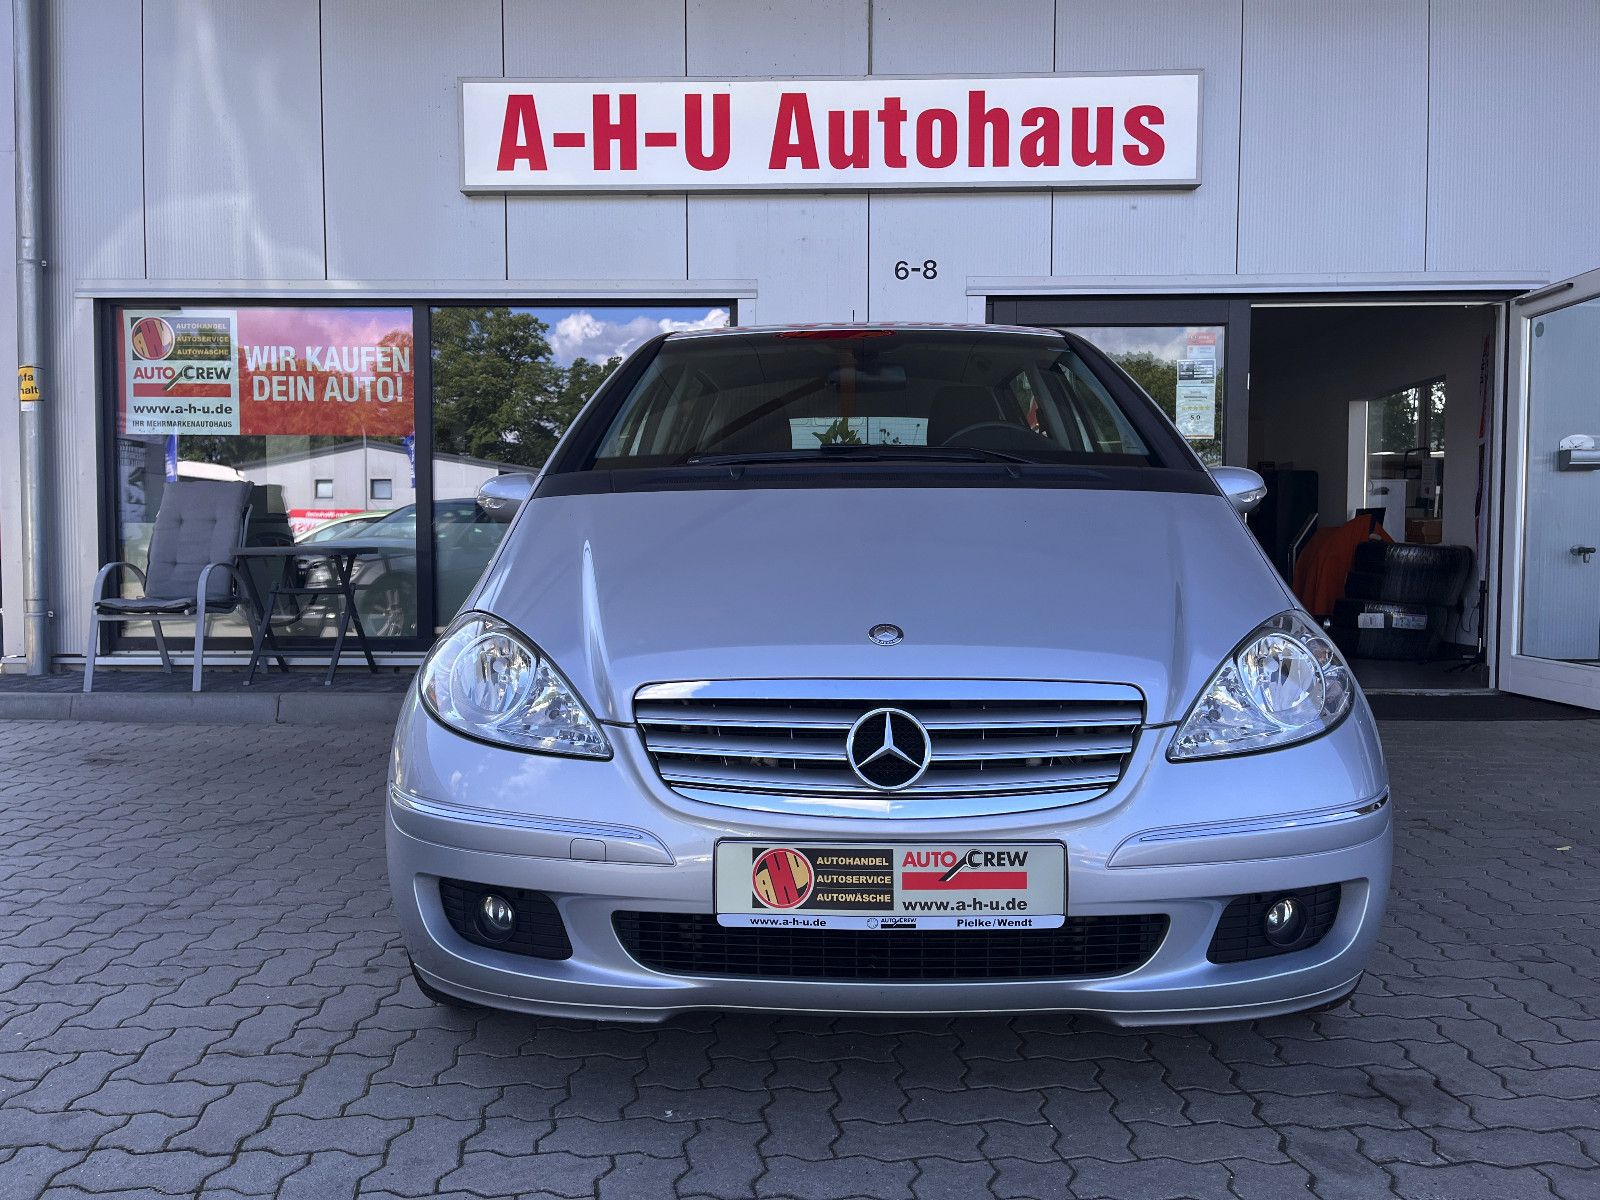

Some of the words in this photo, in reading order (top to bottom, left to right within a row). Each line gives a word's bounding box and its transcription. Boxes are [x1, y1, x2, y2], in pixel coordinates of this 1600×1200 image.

[497, 93, 730, 171] A-H-U
[769, 90, 1165, 170] Autohaus
[895, 260, 937, 281] 6-8
[244, 346, 297, 372] WIR
[306, 346, 410, 373] KAUFEN
[133, 367, 176, 380] AUTO
[183, 366, 231, 380] CREW
[253, 376, 315, 402] DEIN
[324, 376, 403, 403] AUTO!
[133, 404, 233, 414] www.a-h-u.de
[146, 420, 233, 428] MEHRMARKENAUTOHAUS
[817, 857, 889, 866] AUTOHANDEL
[902, 851, 957, 868] AUTO
[967, 850, 1029, 868] CREW
[817, 875, 892, 884] AUTOSERVICE
[817, 893, 891, 903] AUTOWÄSCHE
[902, 898, 1028, 911] www.a-h-u.de
[750, 918, 827, 927] www.a-h-u.de
